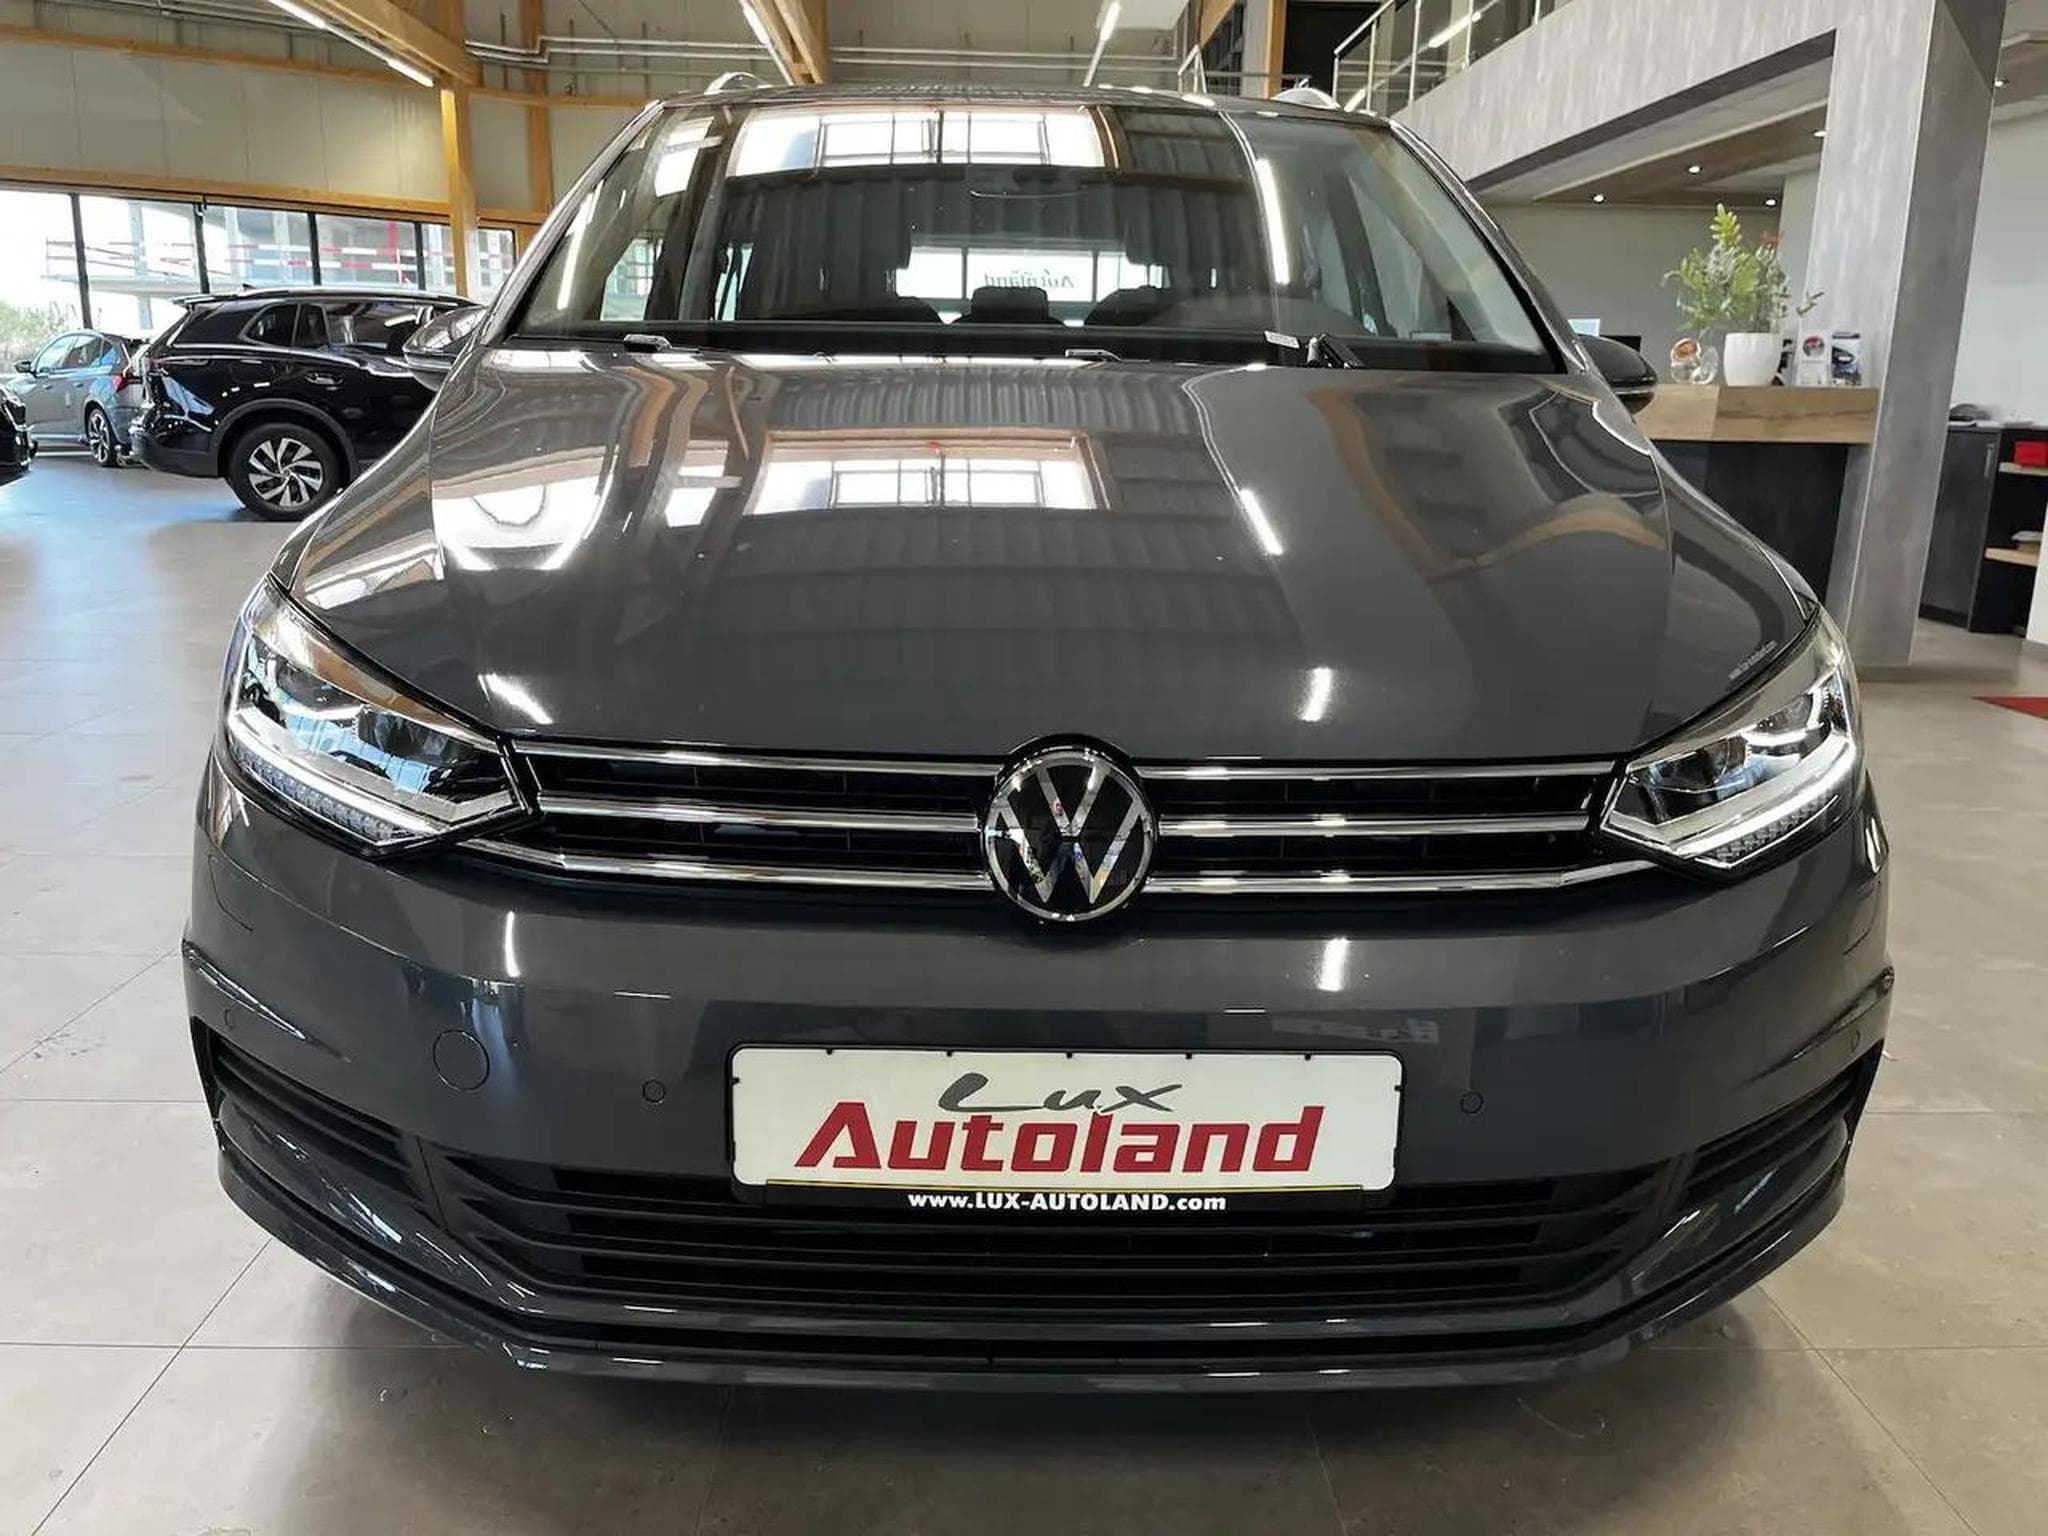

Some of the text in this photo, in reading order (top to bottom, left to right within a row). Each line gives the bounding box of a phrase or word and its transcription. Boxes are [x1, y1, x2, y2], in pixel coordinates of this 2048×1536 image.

[938, 1071, 1183, 1113] Lux
[794, 1102, 1326, 1173] Autoland
[908, 1192, 1226, 1213] www.LUX-AUTOLAND.com
